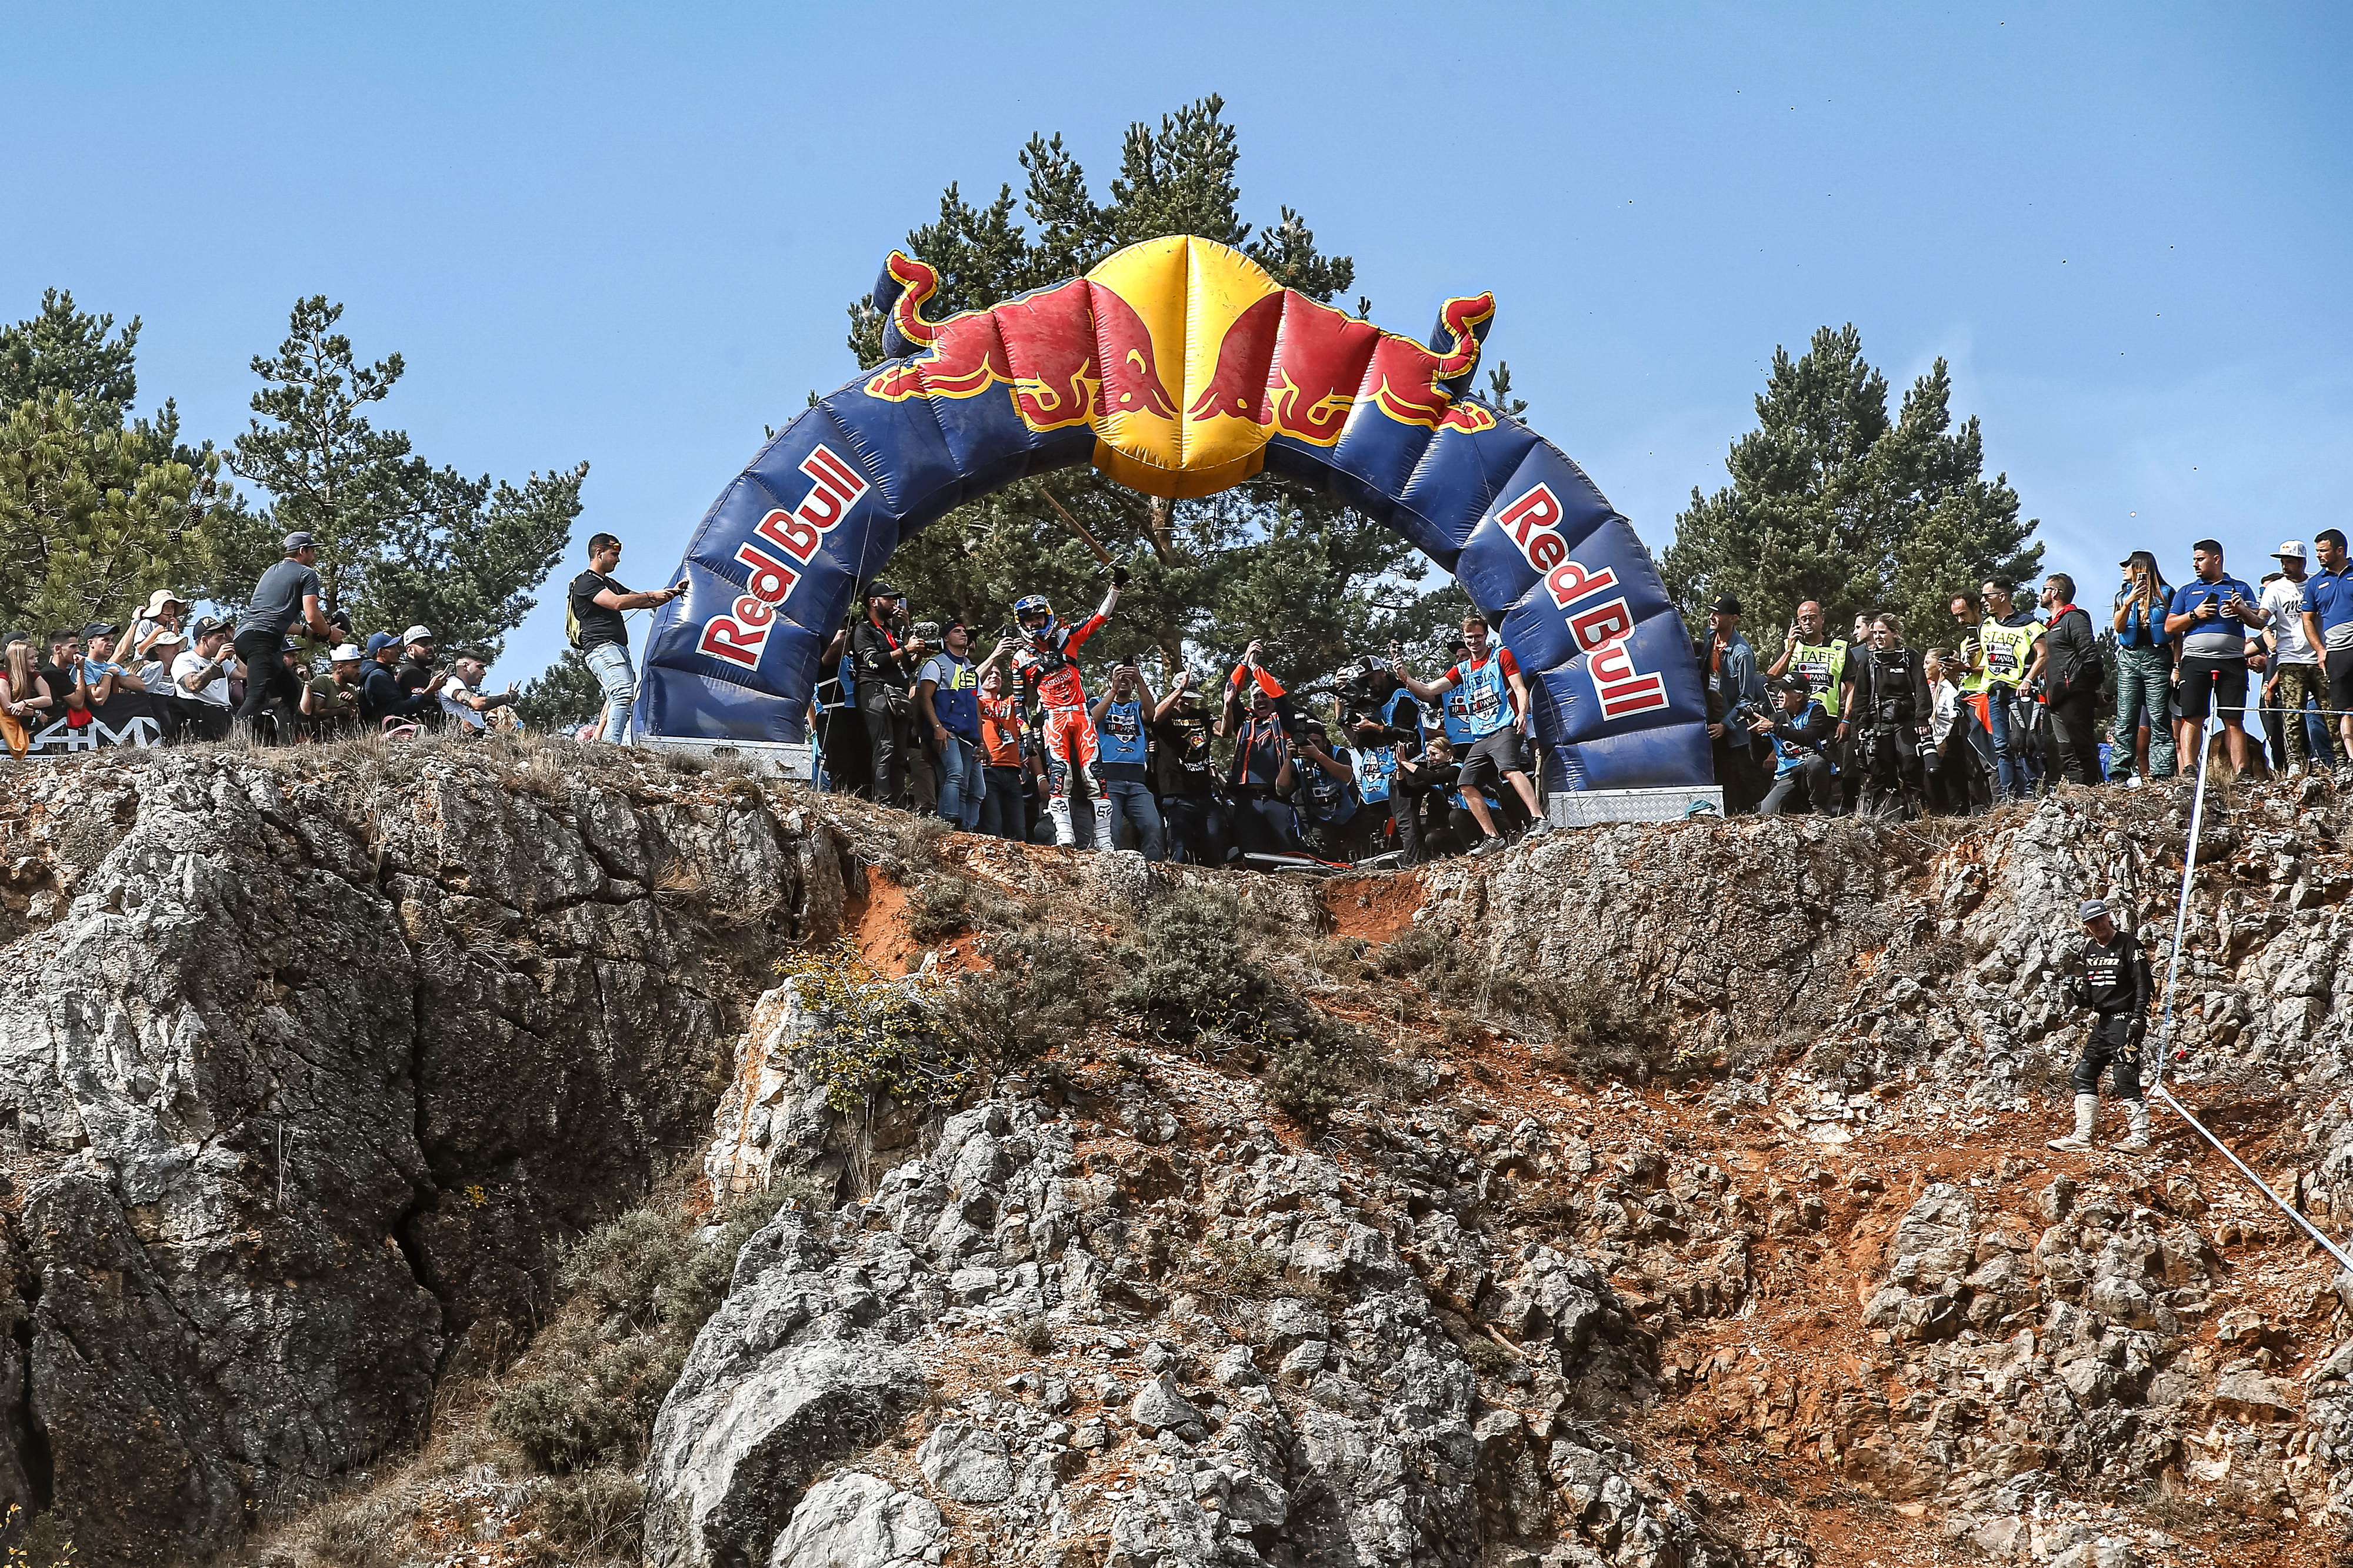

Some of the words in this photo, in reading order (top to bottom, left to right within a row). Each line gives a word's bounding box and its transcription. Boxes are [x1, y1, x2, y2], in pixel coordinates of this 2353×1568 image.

[695, 542, 802, 672] Red
[753, 443, 871, 566] Bull
[1493, 481, 1619, 611] Red
[1565, 596, 1669, 722] Bull
[1984, 631, 2023, 646] STAFF
[1791, 650, 1835, 663] STAFF
[1465, 671, 1497, 690] MDIA
